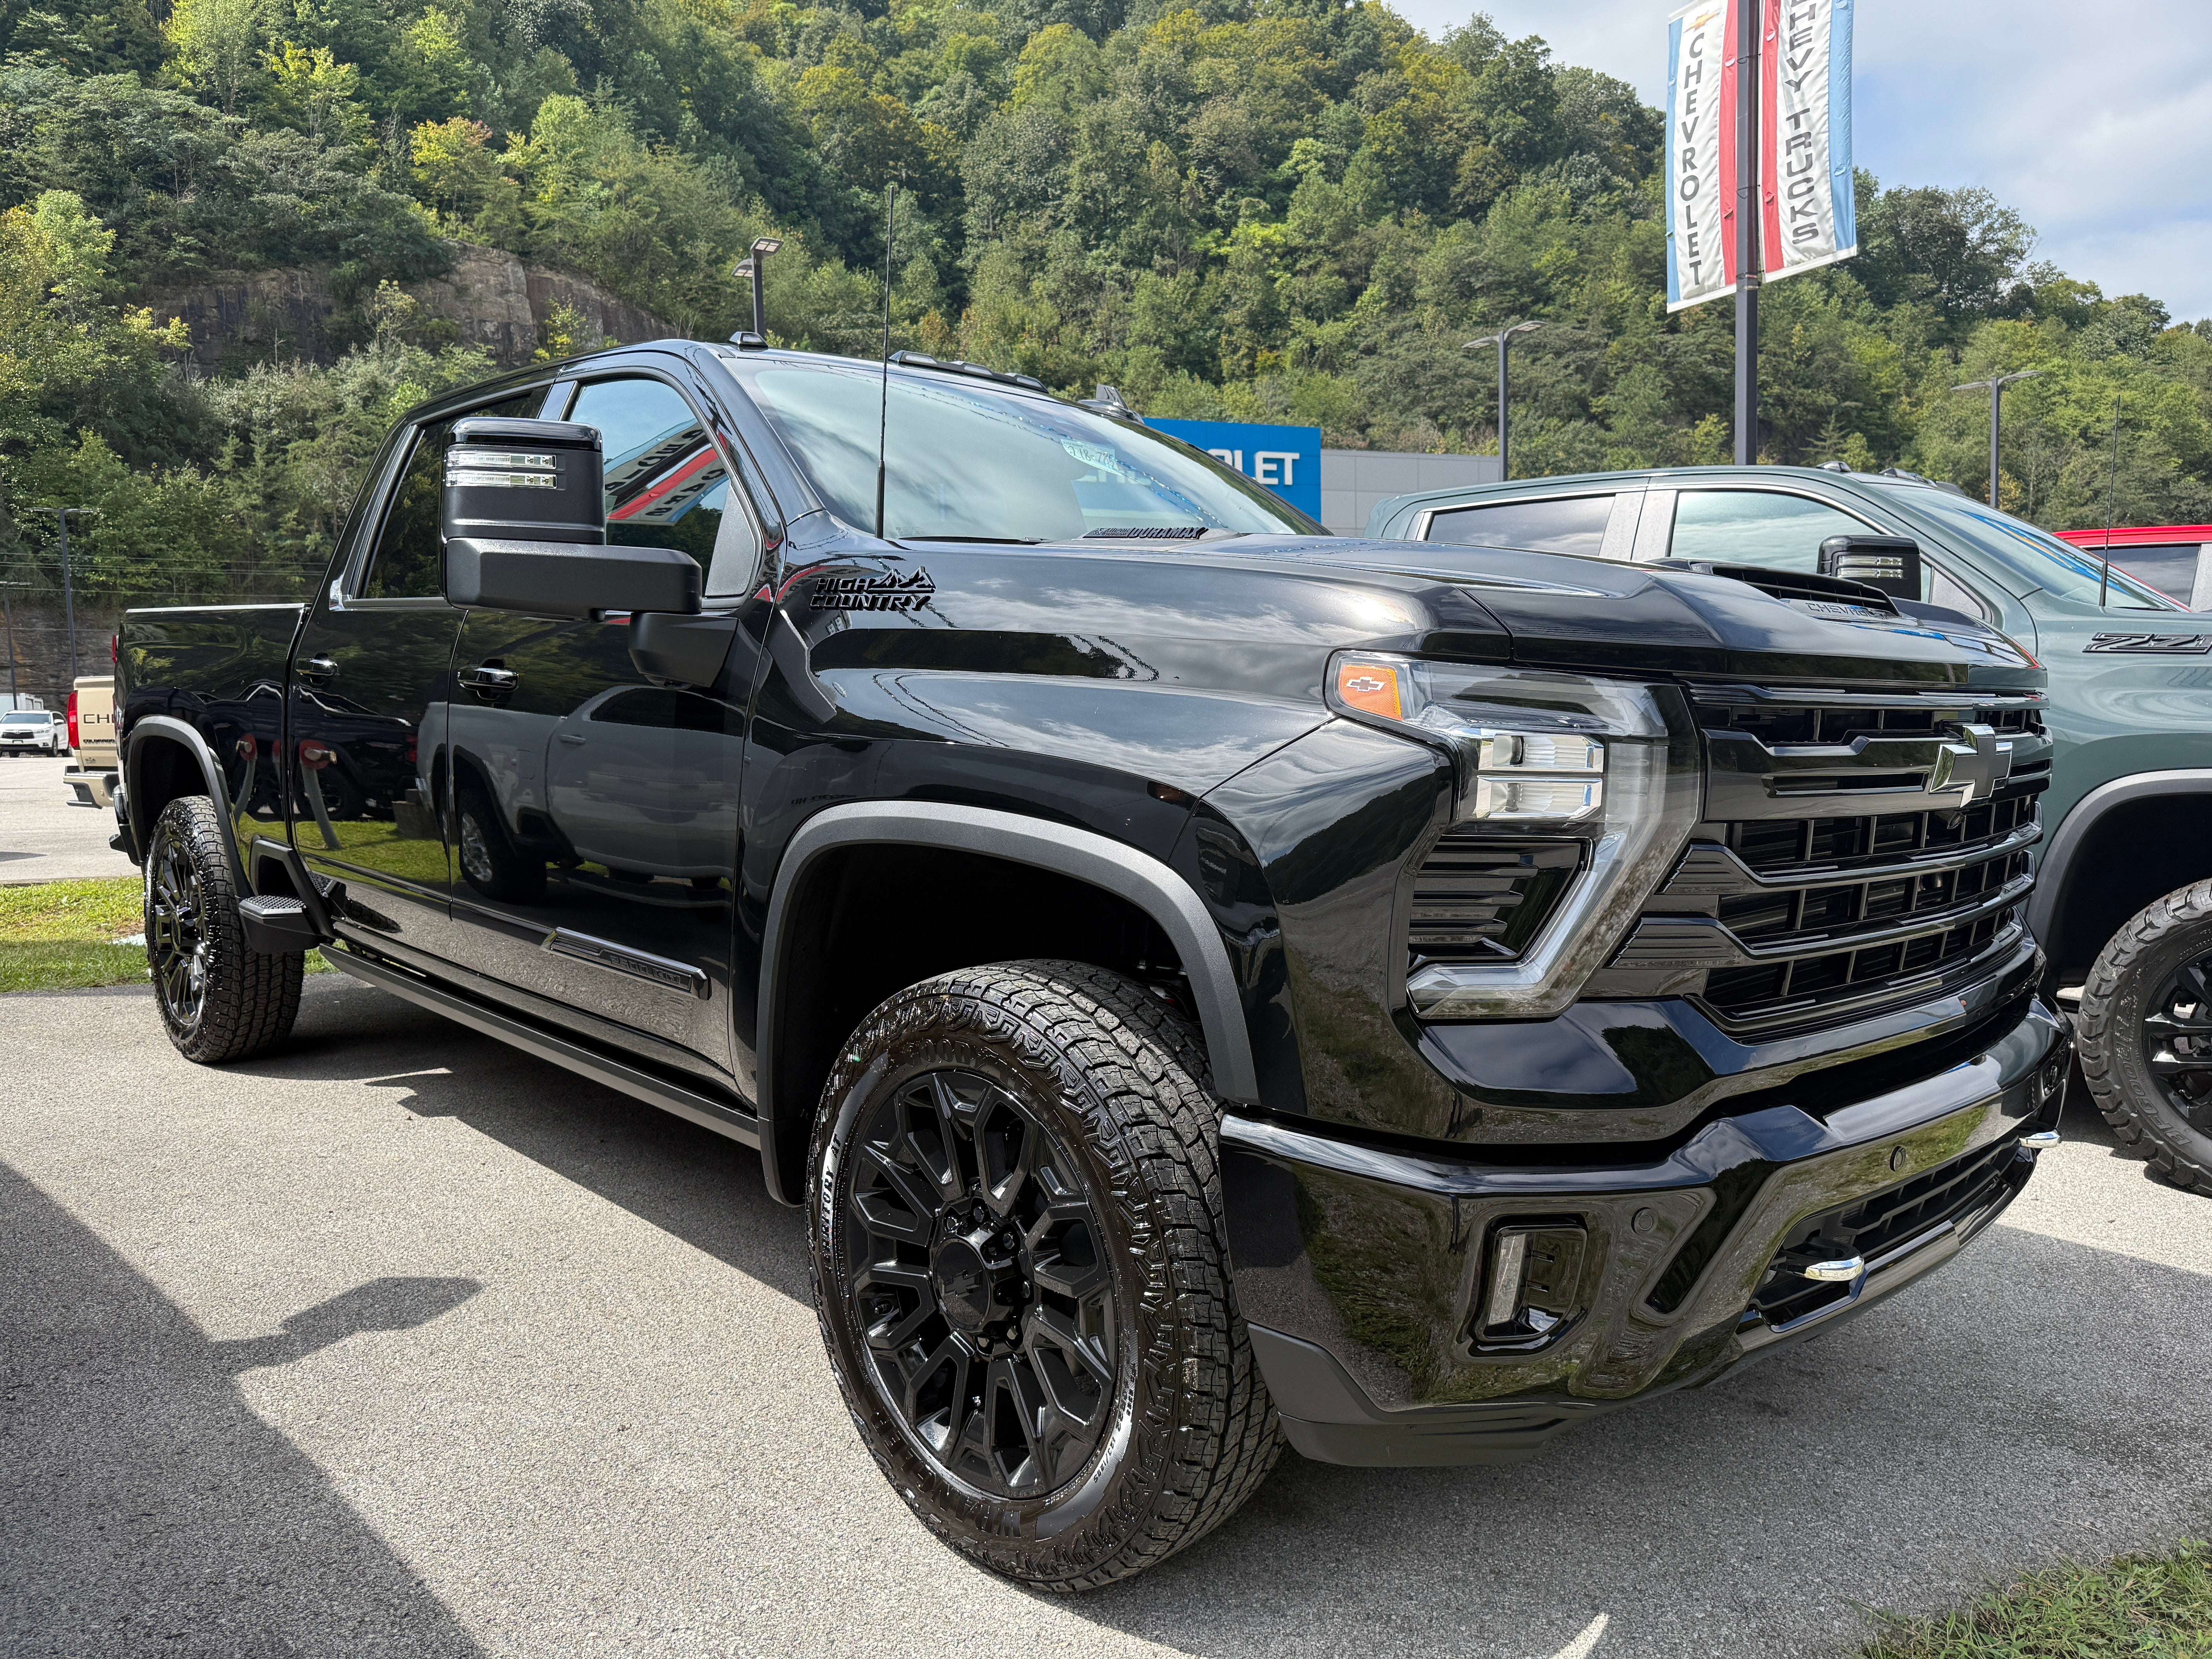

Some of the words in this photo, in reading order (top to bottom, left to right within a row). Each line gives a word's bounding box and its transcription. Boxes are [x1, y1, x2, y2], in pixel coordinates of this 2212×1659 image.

[1784, 0, 1819, 94] HEVY
[1680, 32, 1705, 285] CHEVROLET
[1785, 107, 1819, 245] TRUCKS
[1128, 527, 1201, 539] DURAMAX
[815, 578, 874, 594] HIGH
[809, 594, 931, 611] COUNTRY
[84, 714, 115, 724] CH
[610, 955, 649, 975] 2500
